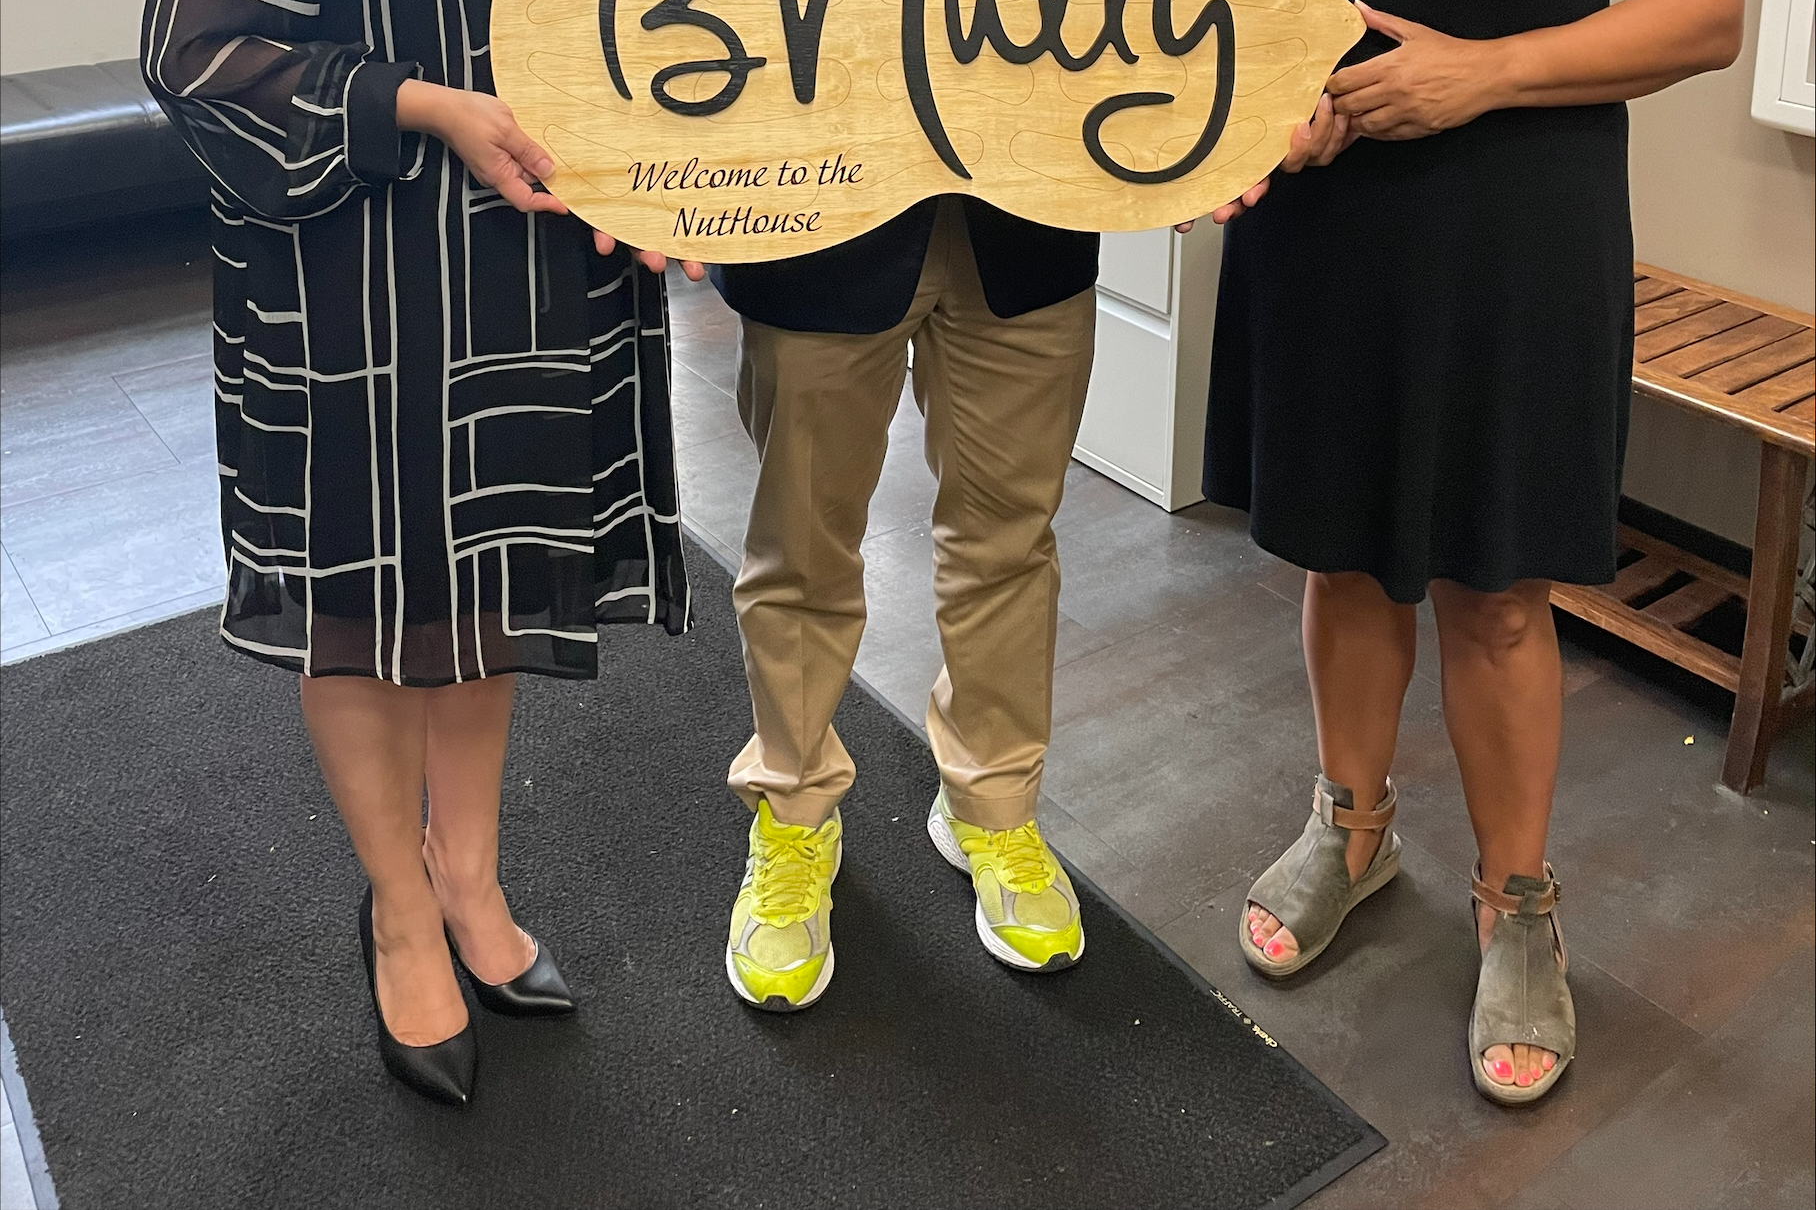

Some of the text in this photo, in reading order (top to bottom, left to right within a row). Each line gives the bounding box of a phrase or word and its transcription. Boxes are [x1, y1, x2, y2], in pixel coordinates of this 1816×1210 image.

[627, 153, 864, 192] Welcome to the
[672, 205, 823, 238] NutHouse
